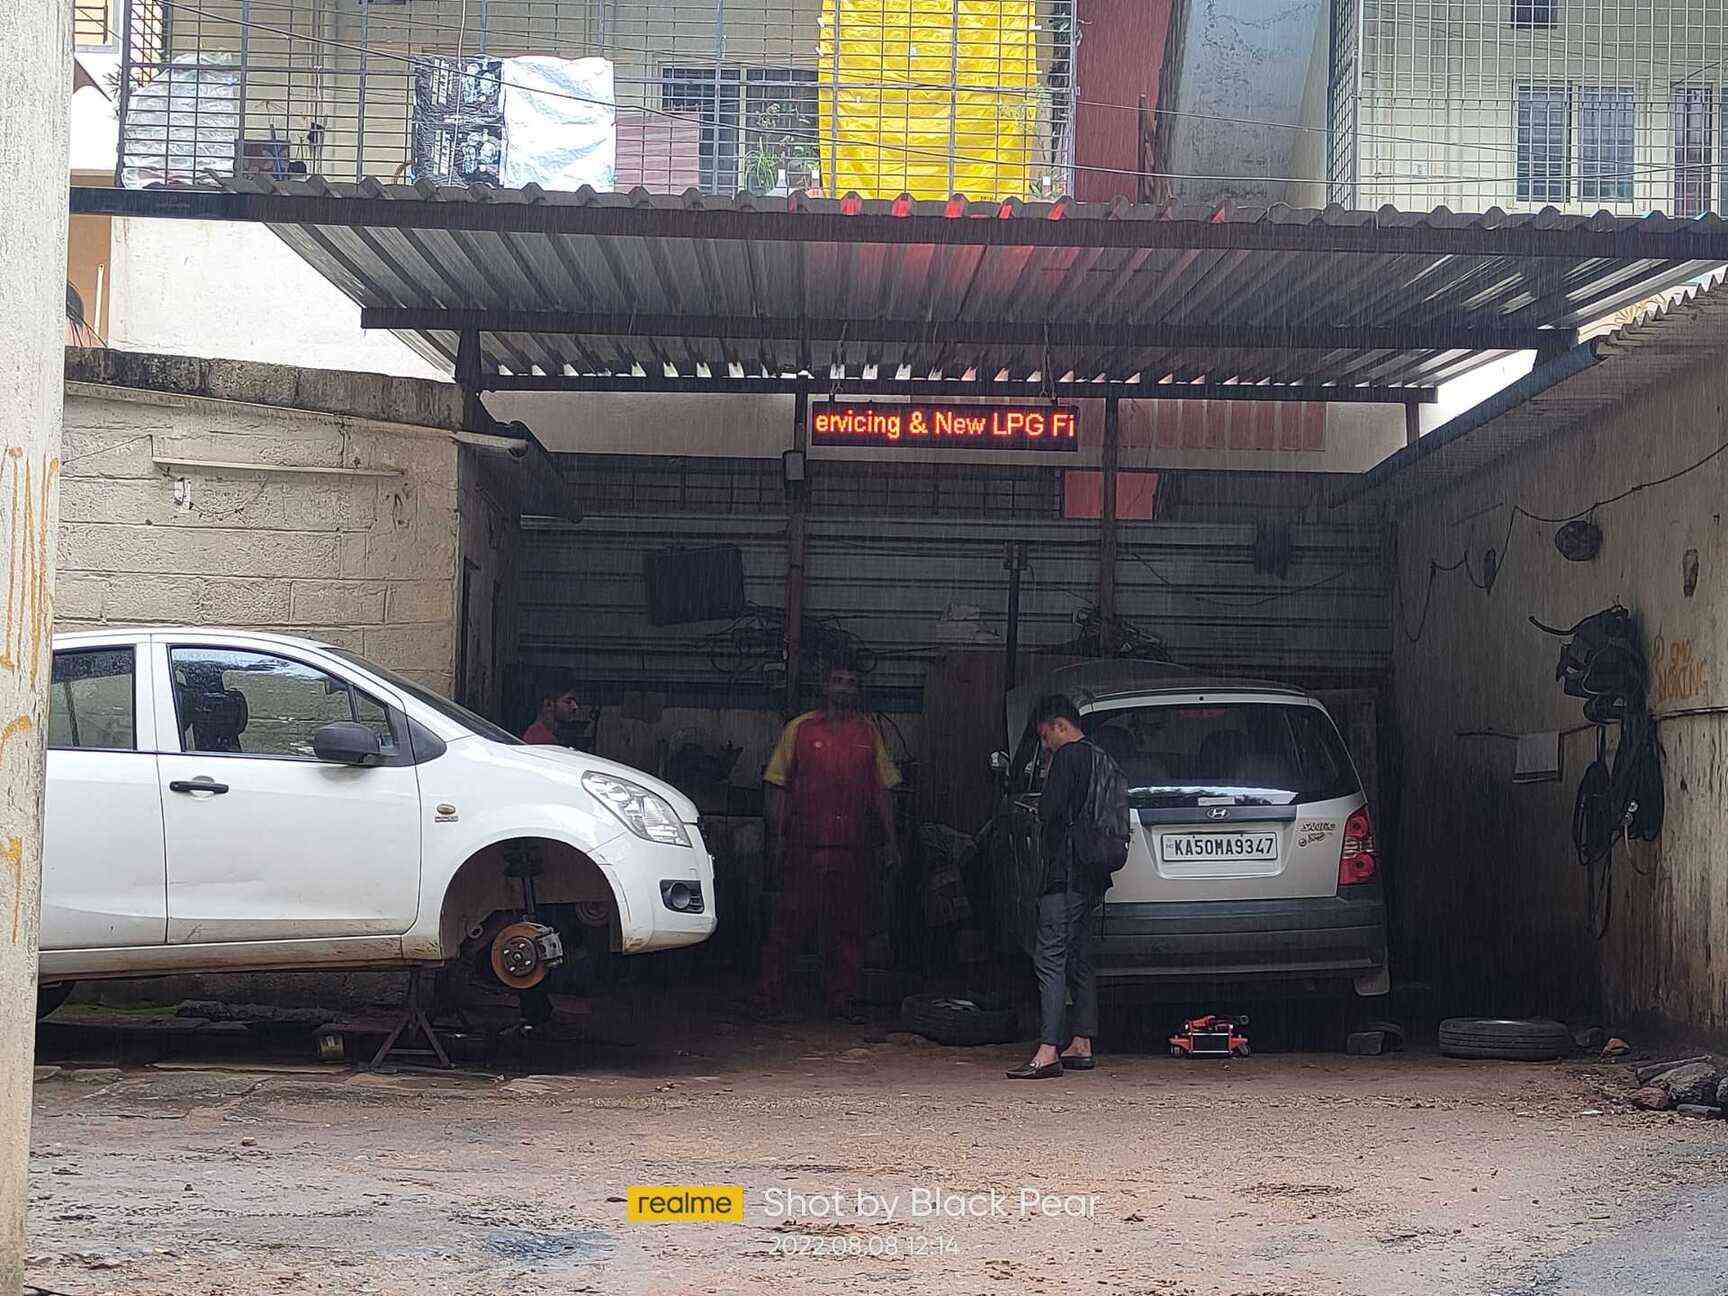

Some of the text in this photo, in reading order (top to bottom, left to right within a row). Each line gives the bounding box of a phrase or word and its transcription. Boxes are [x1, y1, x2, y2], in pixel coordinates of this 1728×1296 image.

[909, 411, 928, 434] &
[935, 412, 986, 434] New
[993, 412, 1045, 436] LPG
[1174, 837, 1274, 856] KA50MA9347
